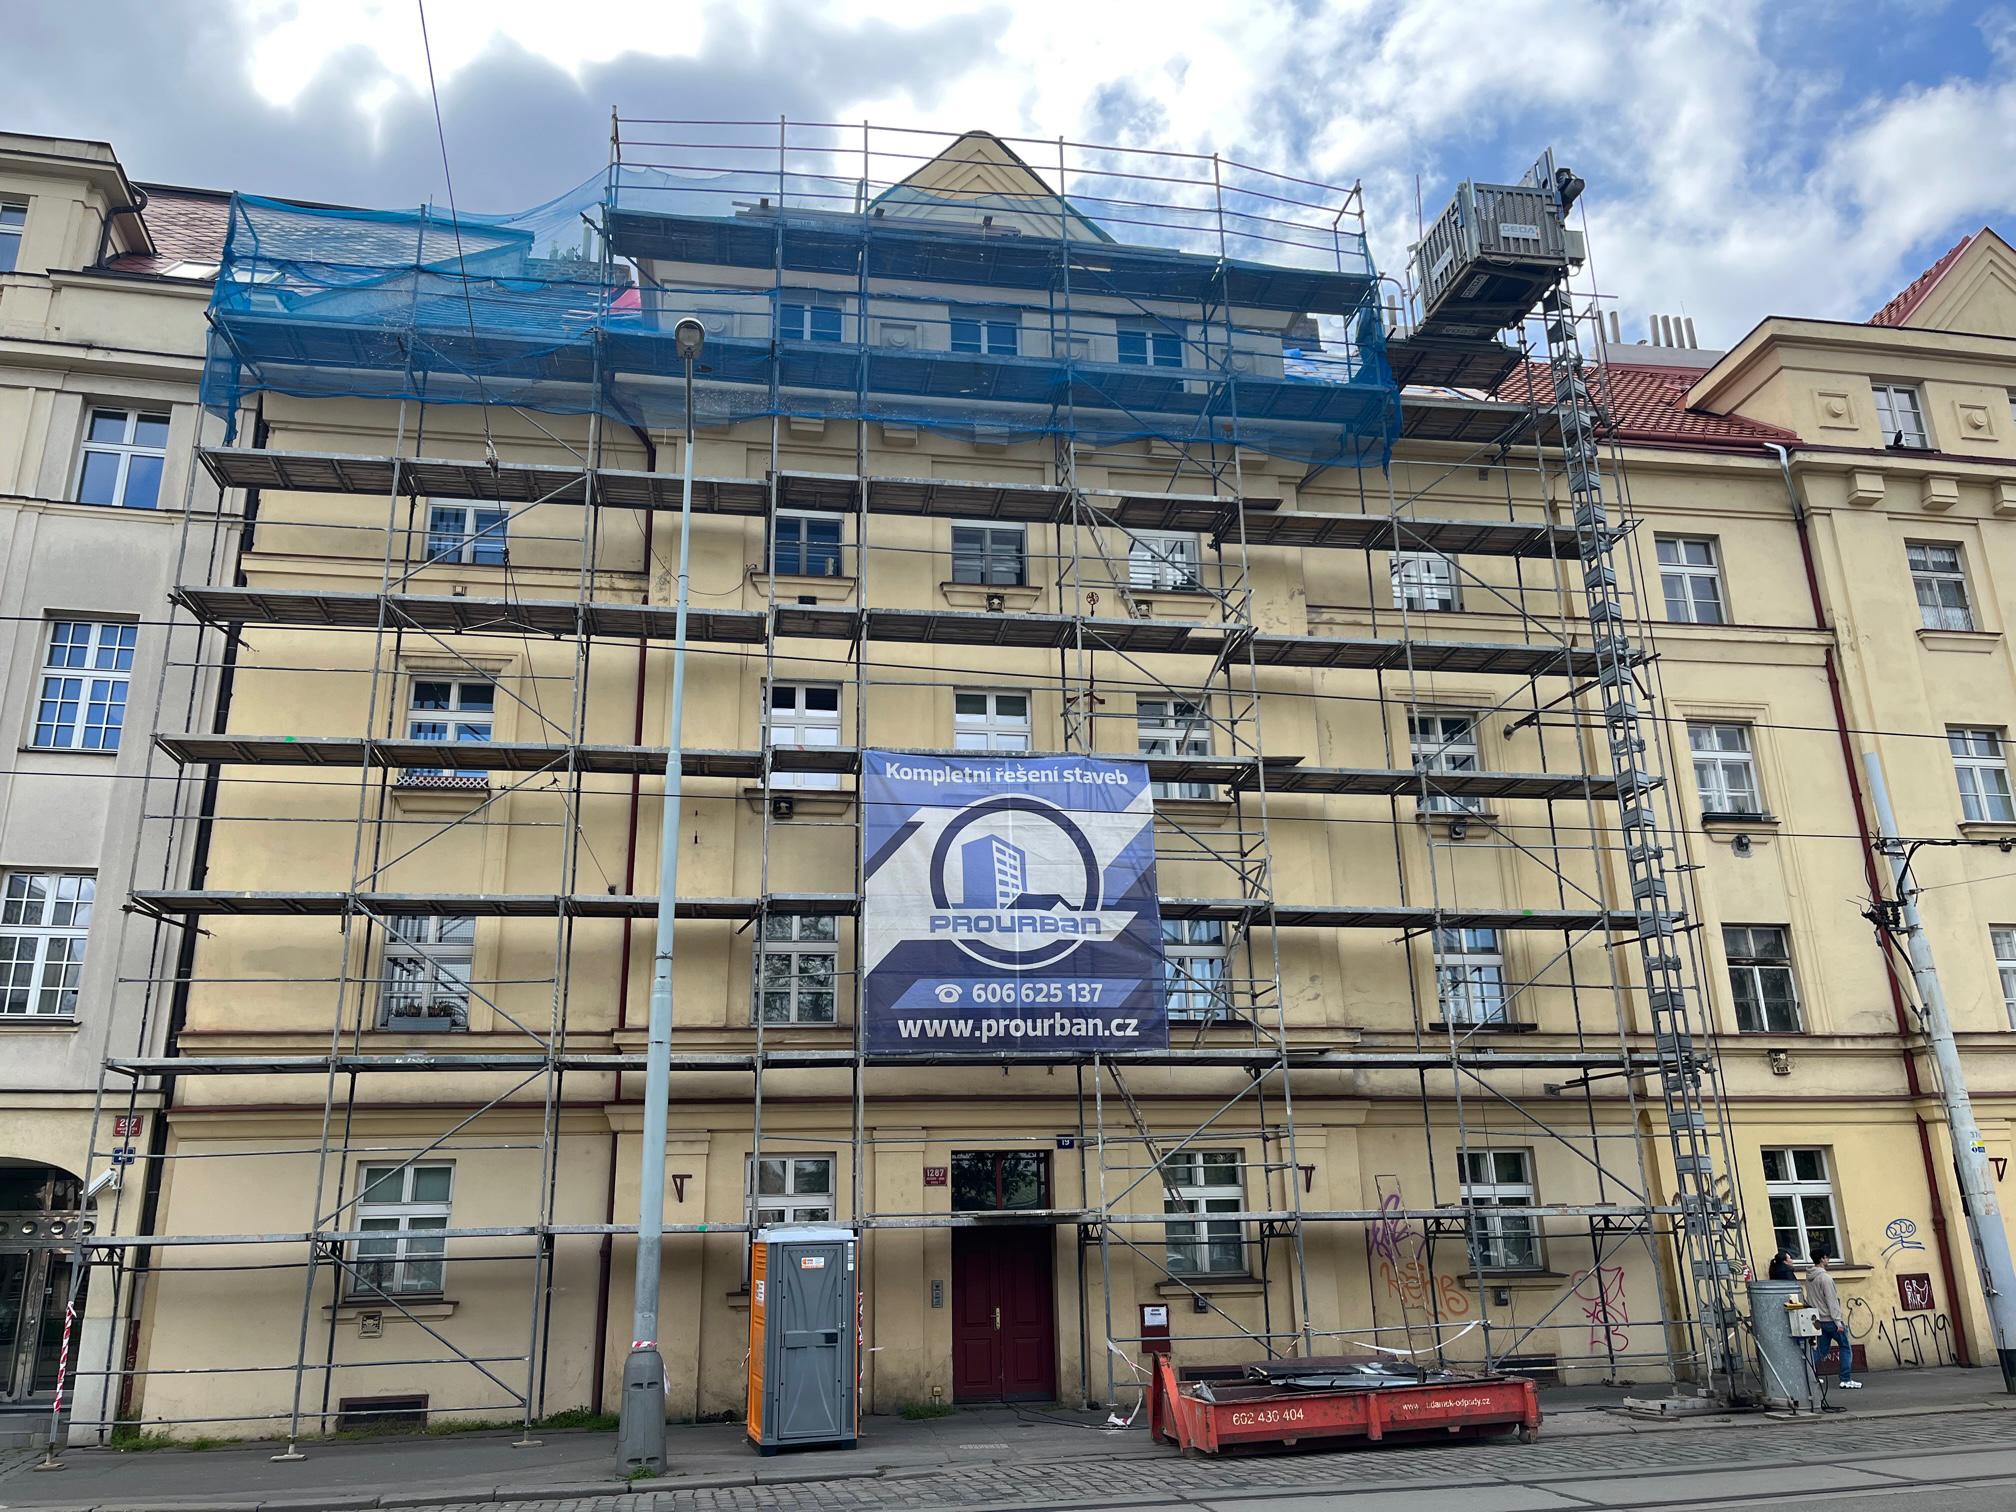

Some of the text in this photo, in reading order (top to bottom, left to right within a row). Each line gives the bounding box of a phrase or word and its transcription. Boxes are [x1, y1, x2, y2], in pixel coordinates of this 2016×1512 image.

[1502, 225, 1535, 234] GEDA
[885, 762, 1129, 786] Kompletní řešení staveb
[972, 983, 1103, 1003] 606 625 137
[897, 1012, 1139, 1043] www.prourban.cz
[927, 1168, 944, 1177] 1287
[1232, 1408, 1304, 1426] 602 430 404
